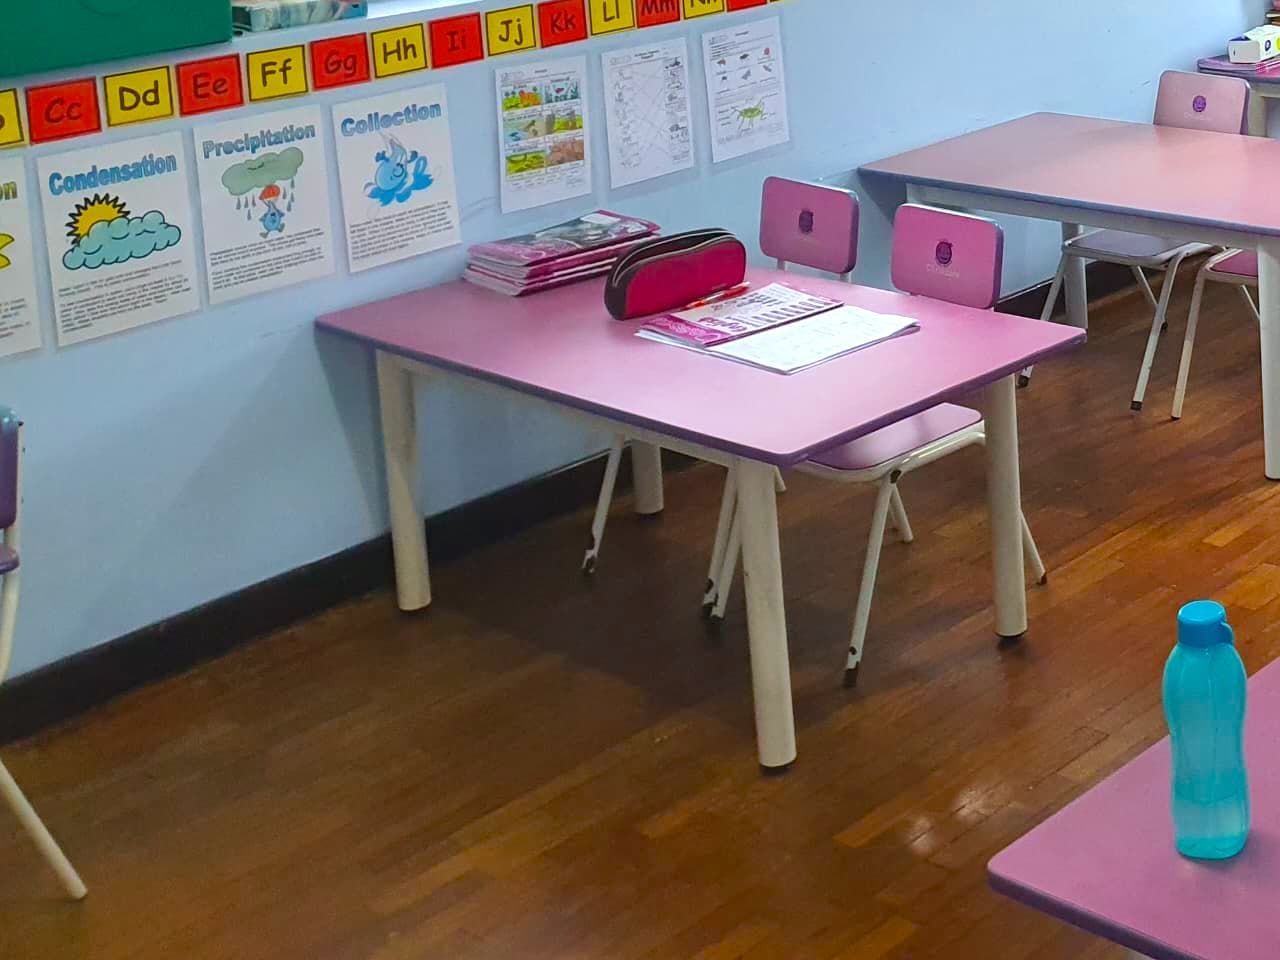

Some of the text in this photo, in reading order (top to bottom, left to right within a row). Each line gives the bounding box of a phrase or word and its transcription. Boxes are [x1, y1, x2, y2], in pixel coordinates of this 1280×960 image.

[44, 97, 82, 125] Cc
[118, 81, 160, 111] Dd
[192, 72, 229, 100] Ee
[260, 57, 293, 87] Ff
[323, 51, 358, 79] Gg
[382, 38, 417, 64] Hh
[446, 28, 467, 52] Ii
[498, 16, 524, 45] Jj
[549, 7, 575, 32] Kk
[340, 100, 442, 138] Collection
[202, 122, 316, 160] Precipitation
[48, 152, 178, 197] Condensation
